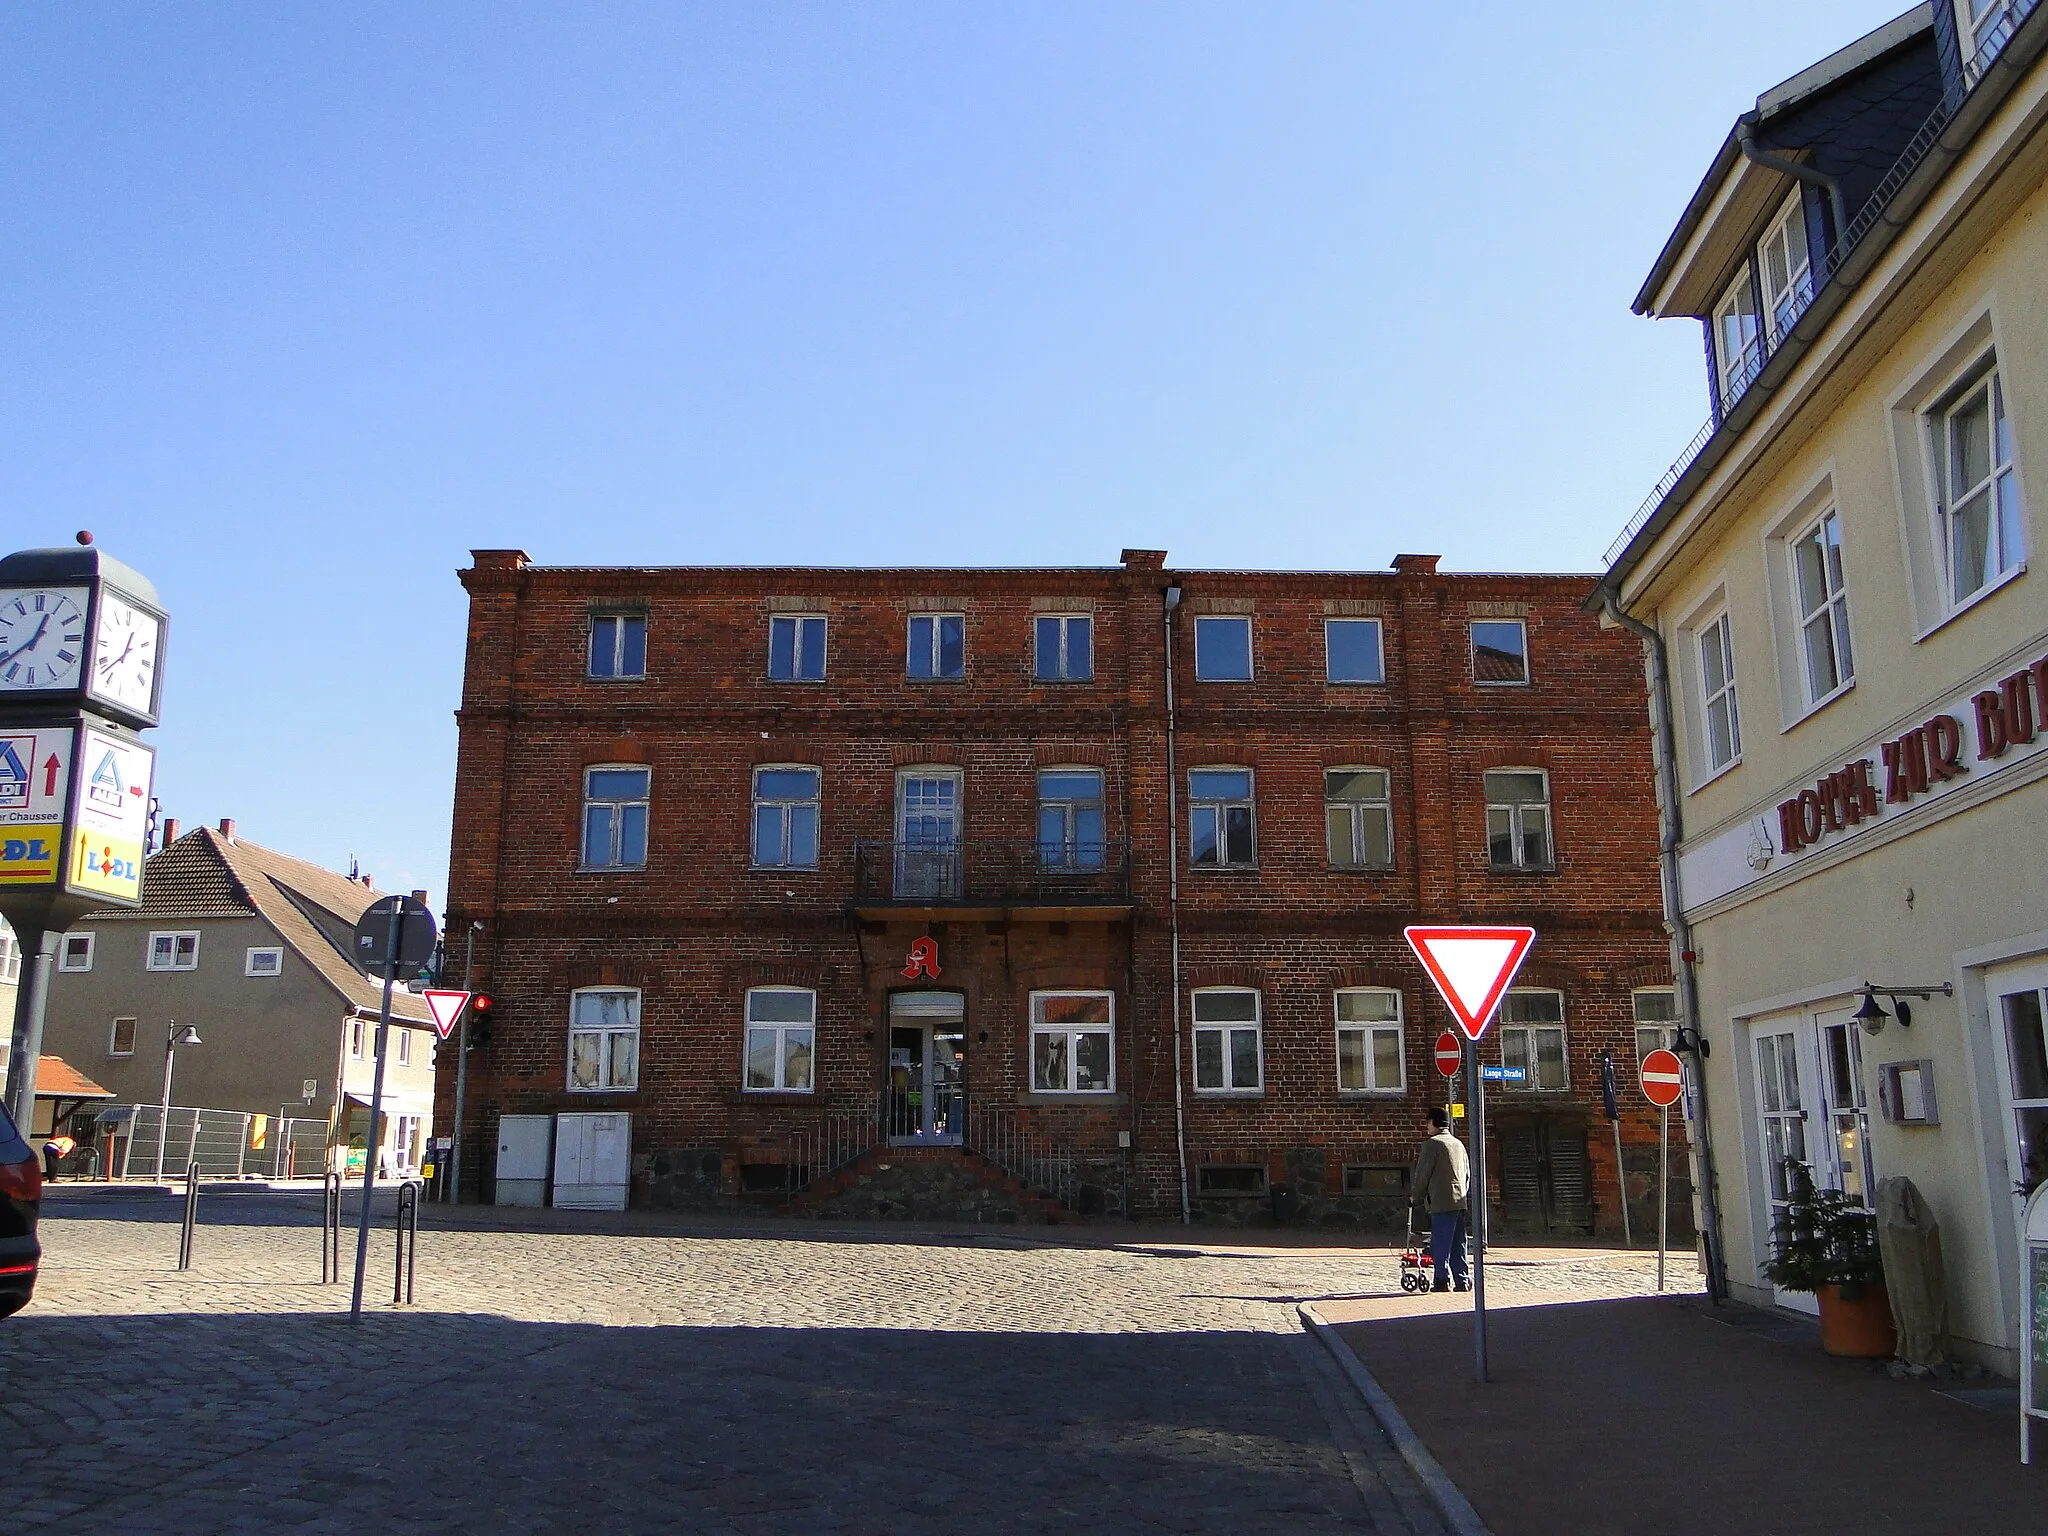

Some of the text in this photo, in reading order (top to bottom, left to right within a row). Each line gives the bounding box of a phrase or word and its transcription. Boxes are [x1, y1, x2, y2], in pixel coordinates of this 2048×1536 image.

[1777, 758, 1877, 854] HOTEL
[1881, 714, 1969, 804] ZUR
[9, 812, 59, 821] Chaussee
[1484, 1068, 1522, 1079] Lange Straße
